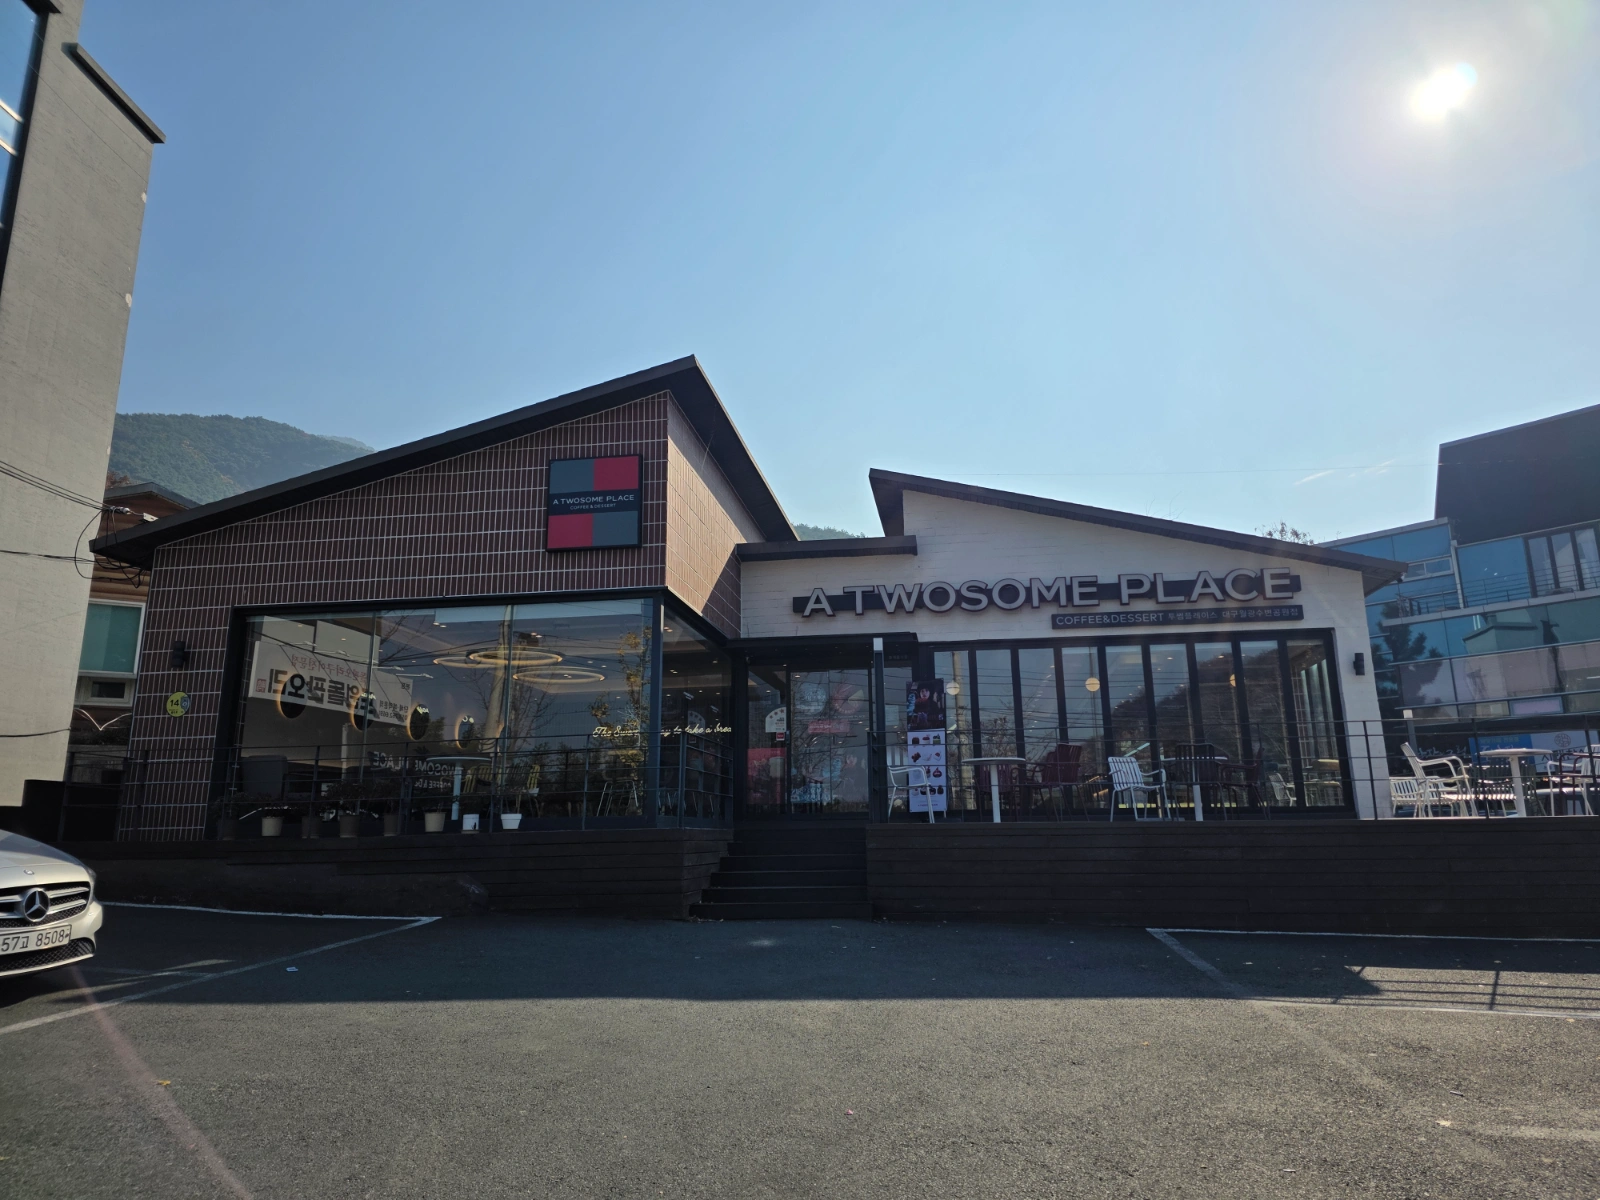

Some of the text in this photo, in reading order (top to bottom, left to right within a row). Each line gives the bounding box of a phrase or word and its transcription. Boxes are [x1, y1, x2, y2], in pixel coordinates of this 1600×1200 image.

[560, 496, 604, 505] TWOSOME
[606, 494, 635, 502] PLACE
[802, 567, 1294, 617] A TWOSOME PLACE
[1056, 607, 1300, 626] COFFEE&DESSERT 투썸플레이스 대구월광수변공원점
[169, 699, 180, 707] 14
[685, 724, 704, 734] take
[714, 722, 732, 733] brea
[35, 929, 65, 947] 8508
